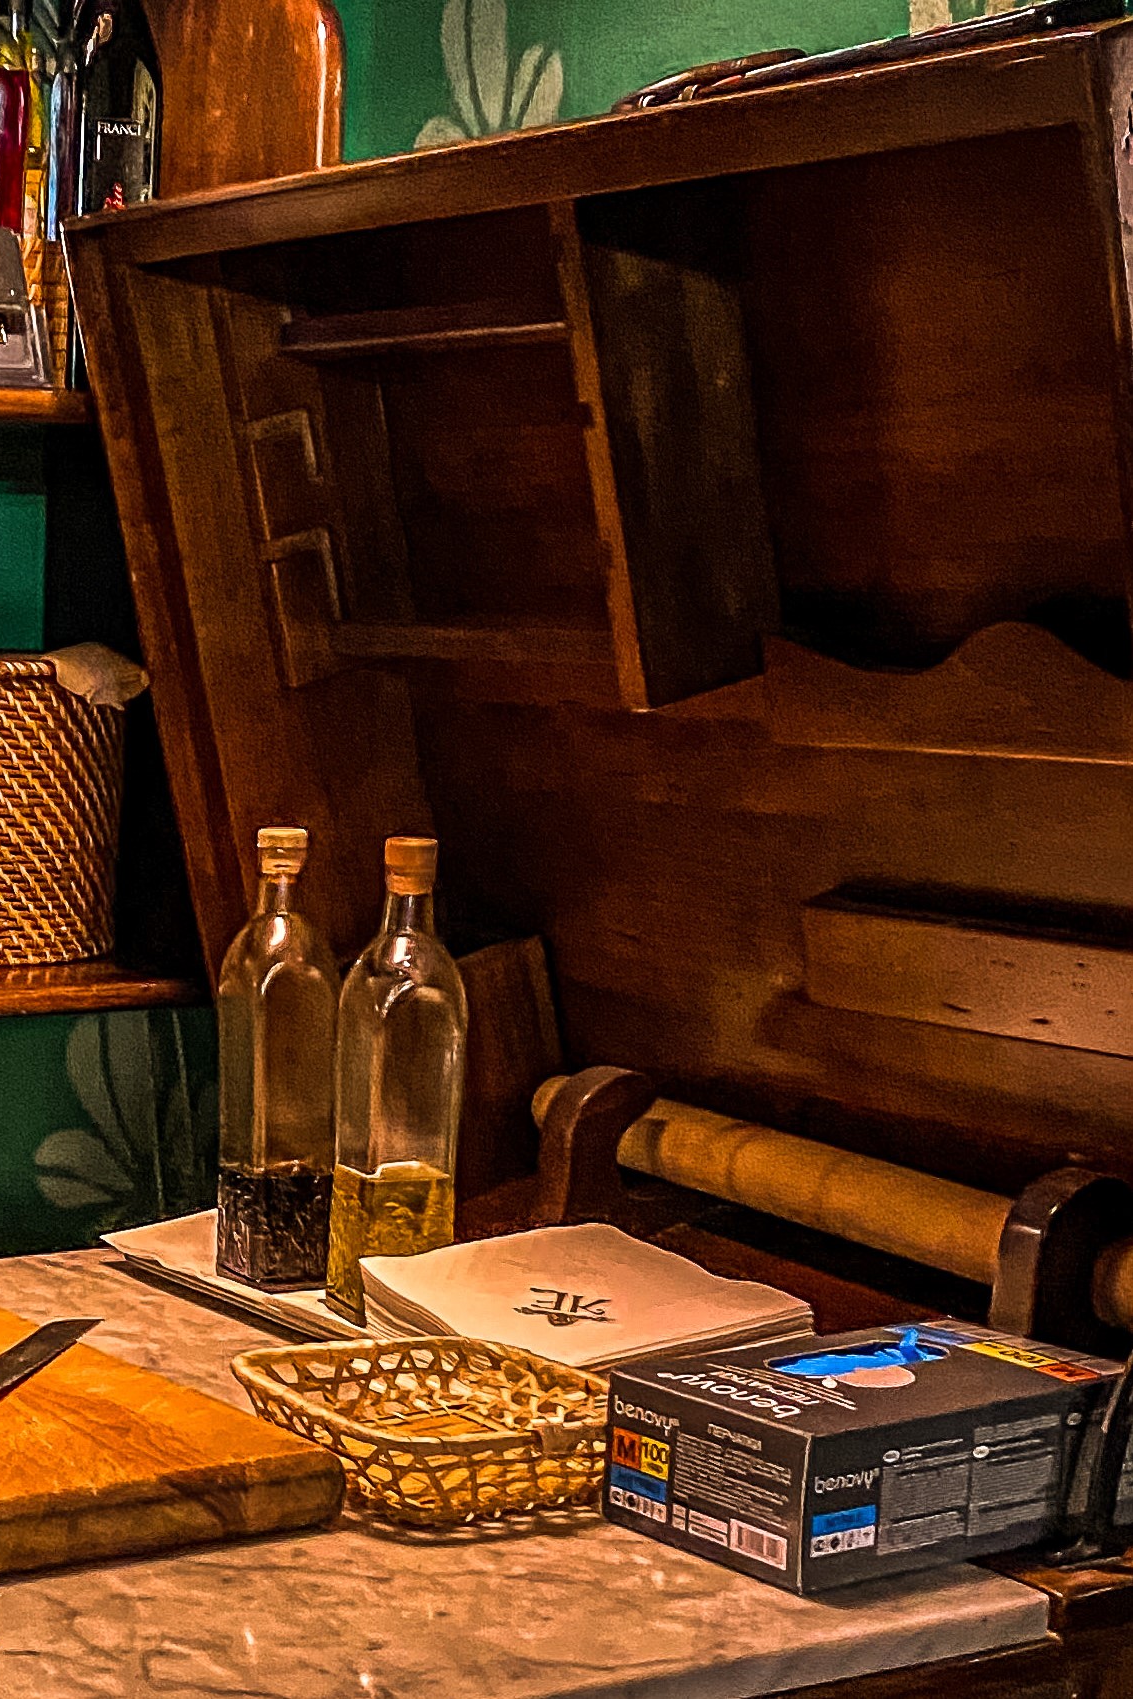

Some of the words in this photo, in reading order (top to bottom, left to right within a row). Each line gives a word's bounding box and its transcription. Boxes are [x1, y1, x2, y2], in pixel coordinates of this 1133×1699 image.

[667, 1372, 801, 1419] benovy
[614, 1394, 673, 1437] benovy
[616, 1434, 637, 1463] M
[641, 1440, 668, 1465] 100
[814, 1469, 874, 1494] benovy
